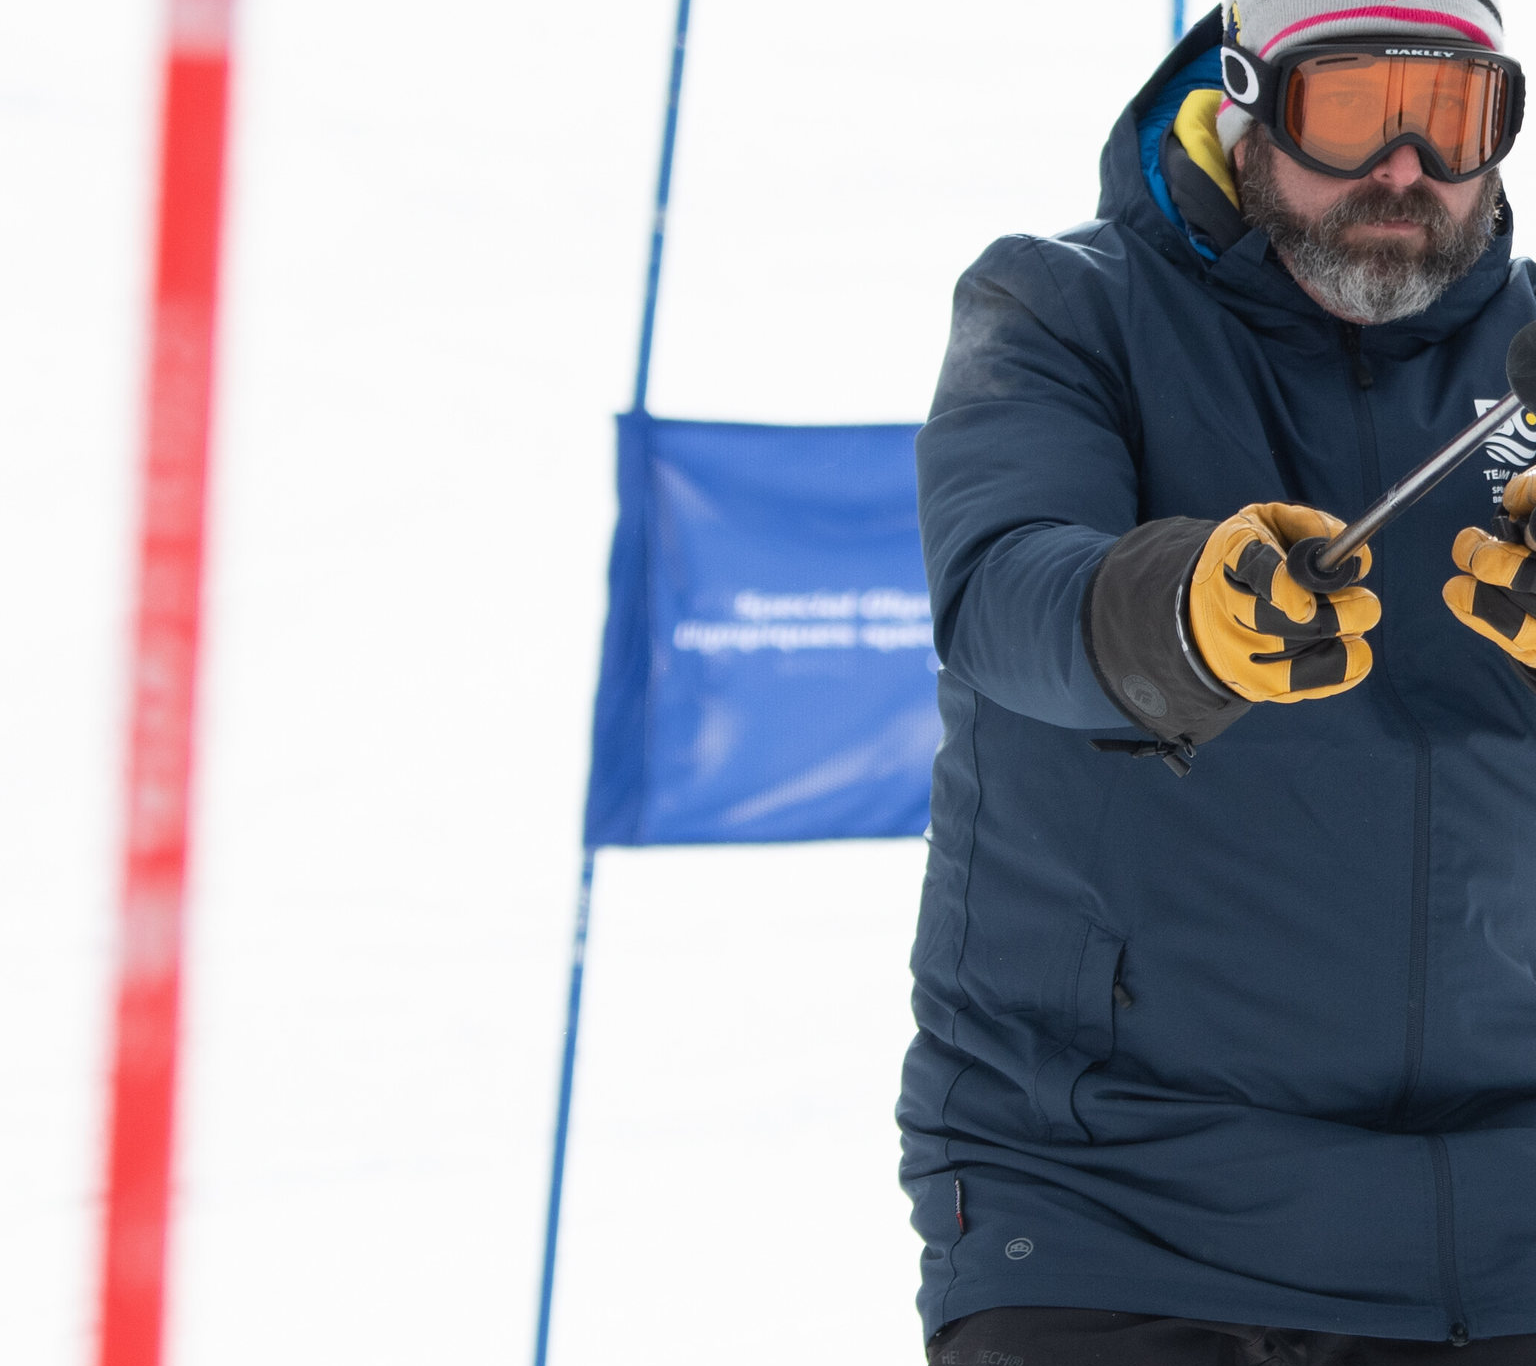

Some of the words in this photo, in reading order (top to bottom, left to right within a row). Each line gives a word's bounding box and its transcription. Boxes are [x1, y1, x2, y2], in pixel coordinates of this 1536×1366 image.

[1385, 48, 1454, 58] OAKLEY
[1483, 469, 1511, 481] TEAM
[734, 587, 858, 620] Special
